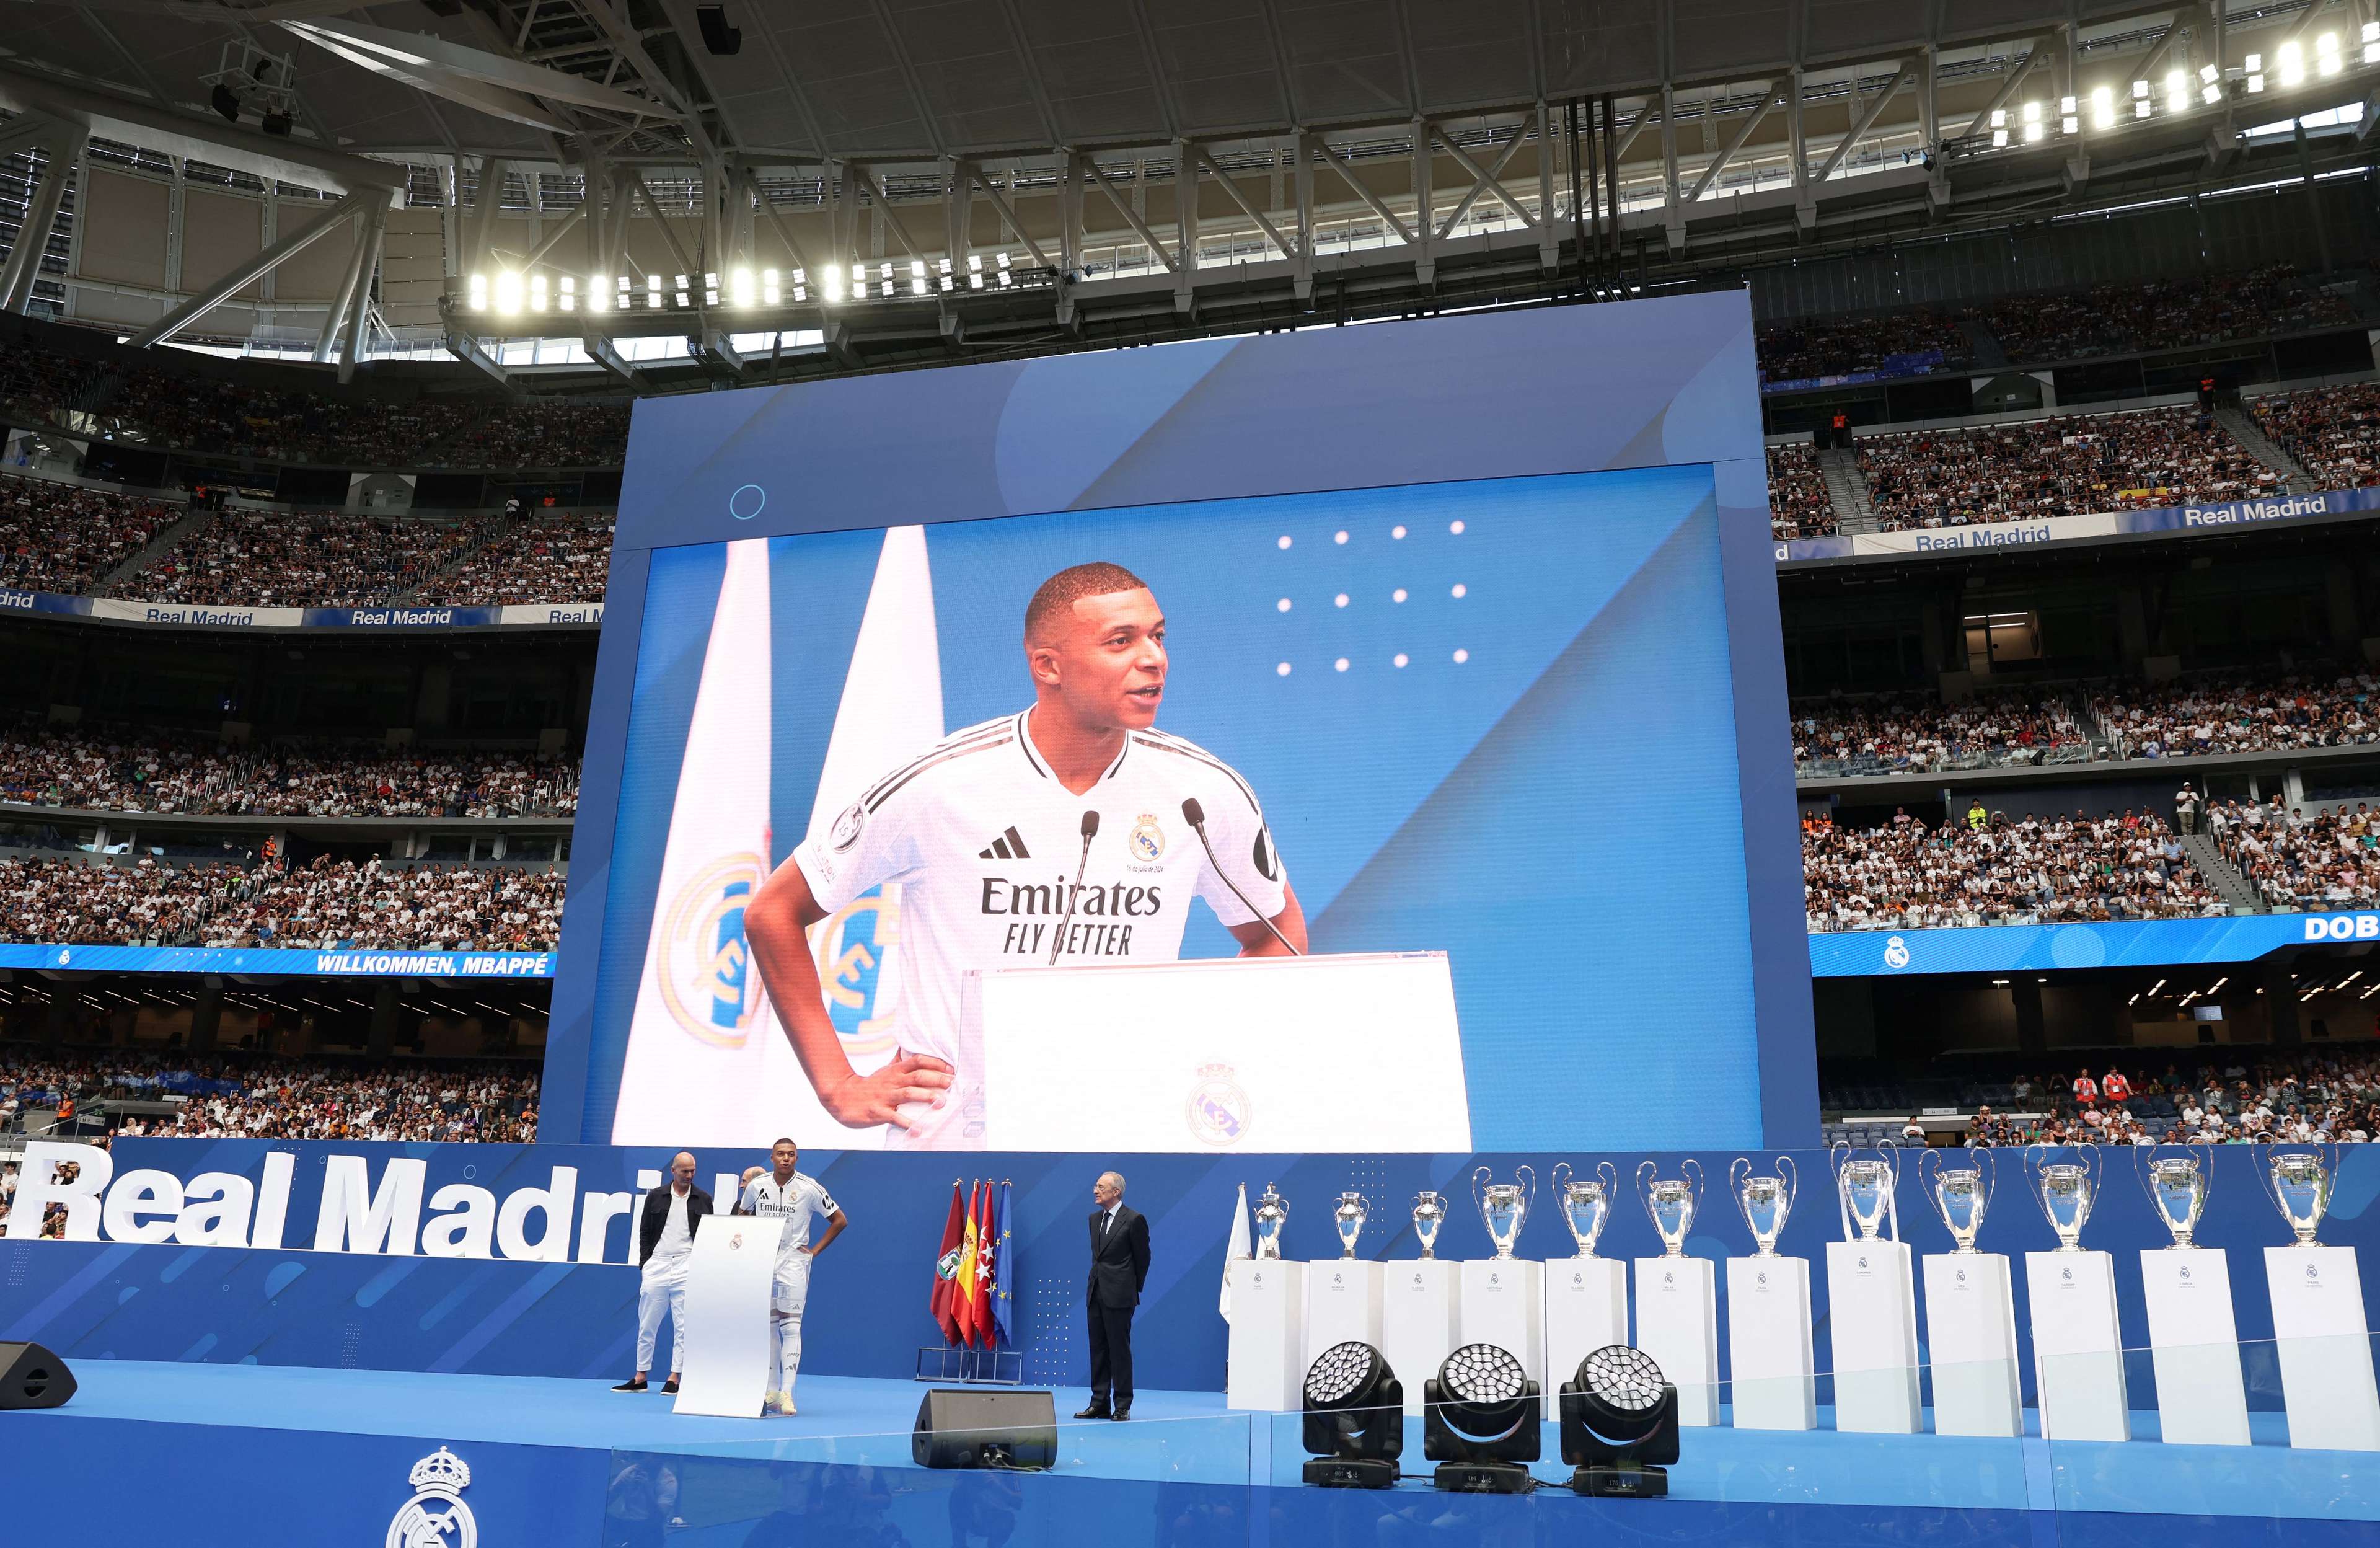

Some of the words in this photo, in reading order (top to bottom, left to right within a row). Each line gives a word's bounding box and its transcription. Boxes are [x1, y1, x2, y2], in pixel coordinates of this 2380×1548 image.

[2185, 505, 2236, 526] Real
[2242, 496, 2327, 520] Madrid
[1916, 531, 1964, 551] Real
[1972, 525, 2051, 547] Madrid
[146, 608, 186, 624] Real
[191, 610, 253, 626] Madrid
[351, 610, 389, 625] Real
[392, 609, 452, 625] Madrid
[549, 609, 587, 624] Real
[981, 875, 1161, 916] Emirates
[1003, 923, 1046, 954] FLY
[2304, 914, 2379, 940] DOB
[317, 955, 456, 976] WILLKOMMEN,
[462, 952, 549, 975] MBAPPÉ
[6, 1141, 296, 1249] Real
[760, 1202, 796, 1213] Emirates
